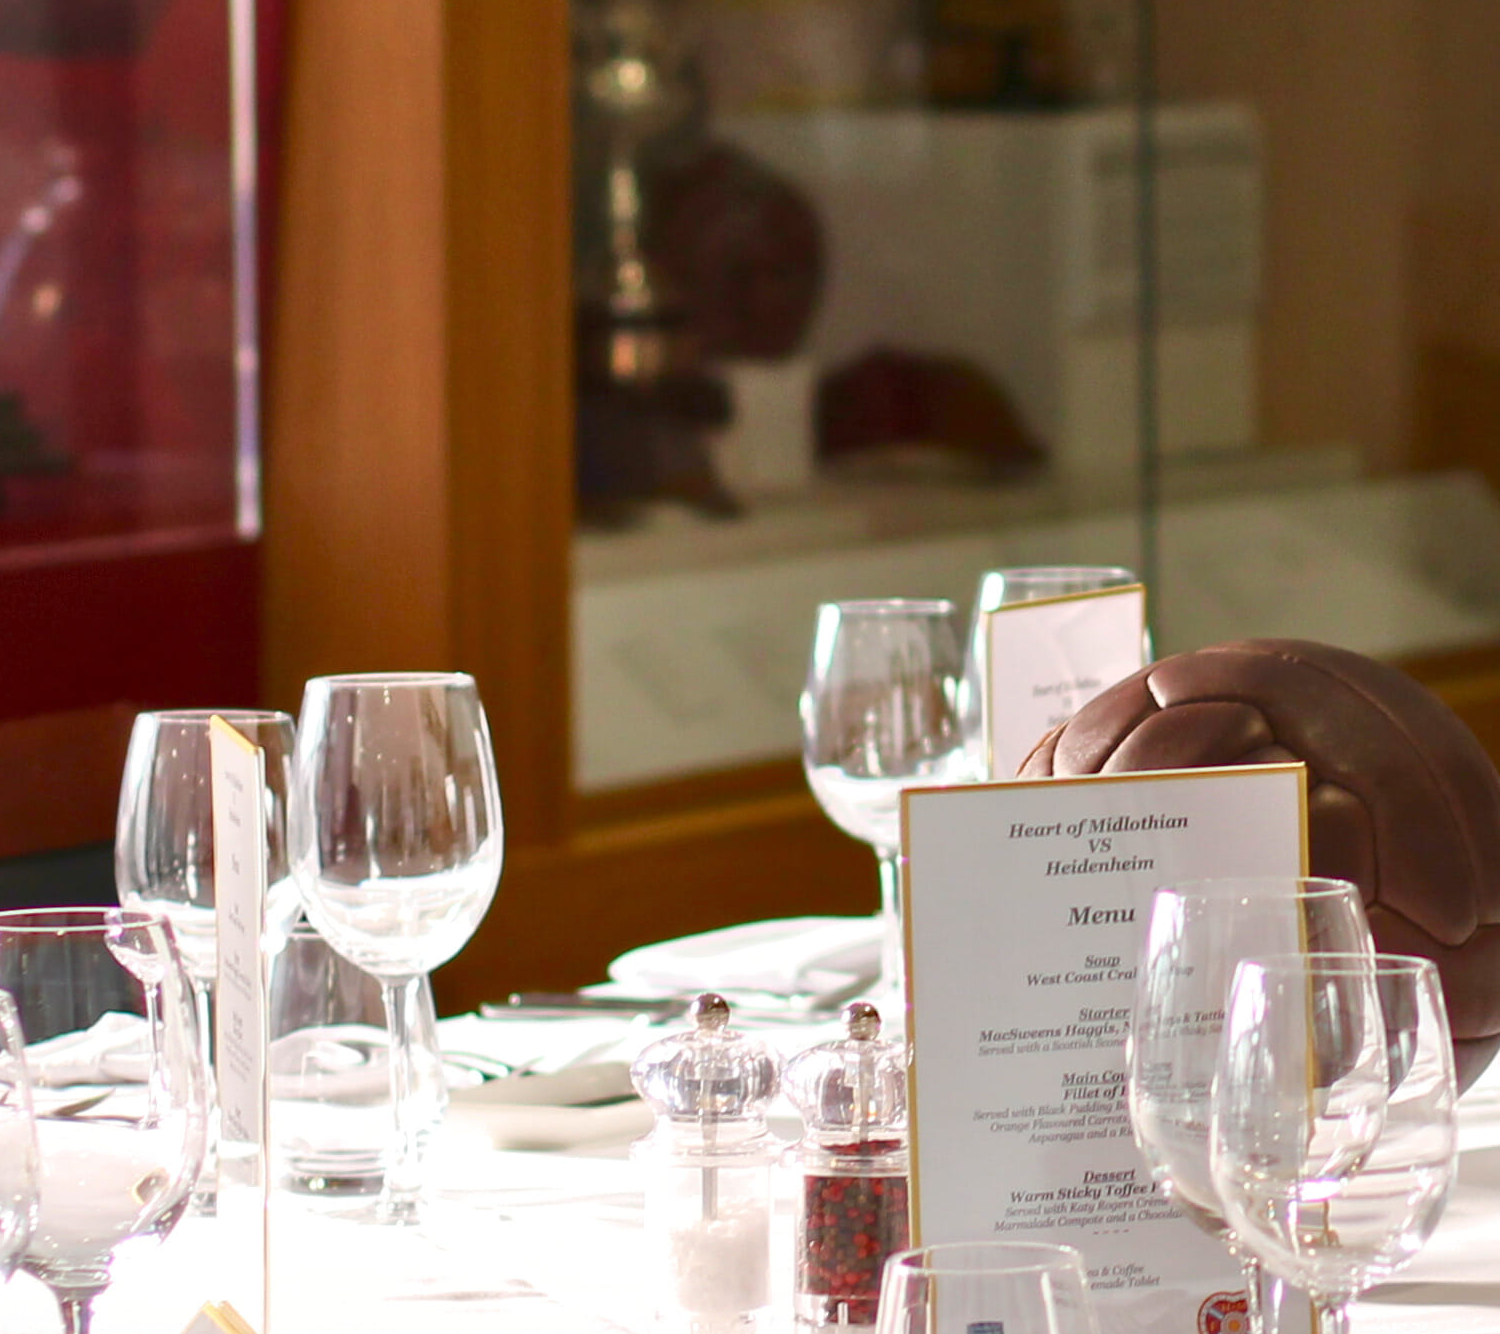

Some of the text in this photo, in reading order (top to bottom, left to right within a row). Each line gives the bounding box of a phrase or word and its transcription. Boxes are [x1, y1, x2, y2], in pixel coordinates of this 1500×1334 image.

[1008, 813, 1189, 839] Heart of Midlothian
[1088, 838, 1112, 854] VS
[1045, 855, 1155, 876] Heidenheim
[1067, 906, 1136, 927] Menu
[1084, 954, 1121, 970] Soup
[1026, 973, 1061, 987] West
[1064, 969, 1104, 985] Coast
[1078, 1006, 1131, 1023] Starter
[978, 1027, 1062, 1044] MacSweens
[1064, 1021, 1120, 1042] Haggis,
[978, 1042, 1015, 1057] Served
[1016, 1040, 1041, 1054] with
[1042, 1042, 1051, 1053] a
[1051, 1037, 1094, 1052] Scottish
[1062, 1072, 1099, 1087] Main
[1063, 1085, 1100, 1101] Fillet
[1103, 1083, 1119, 1101] of
[973, 1108, 1010, 1122] Served
[1011, 1105, 1036, 1119] with
[1038, 1102, 1066, 1117] Black
[1069, 1099, 1114, 1116] Pudding
[990, 1119, 1030, 1134] Orange
[1032, 1114, 1086, 1131] Flavoured
[1028, 1130, 1085, 1146] Asparagus
[1087, 1127, 1107, 1140] and
[1109, 1129, 1117, 1139] a
[1083, 1168, 1136, 1185] Dessert
[1010, 1191, 1055, 1204] Warm
[1057, 1185, 1102, 1202] Sticky
[1105, 1183, 1148, 1199] Toffee
[1005, 1205, 1042, 1218] Served
[1043, 1202, 1068, 1216] with
[1069, 1199, 1097, 1216] Katy
[1097, 1197, 1134, 1213] Rogers
[994, 1218, 1057, 1232] Marmalade
[1057, 1213, 1104, 1229] Compote
[1106, 1211, 1126, 1224] and
[1128, 1213, 1136, 1222] a
[1102, 1267, 1112, 1277] &
[1113, 1264, 1145, 1277] Coffee
[1090, 1274, 1161, 1291] emade Tablet
